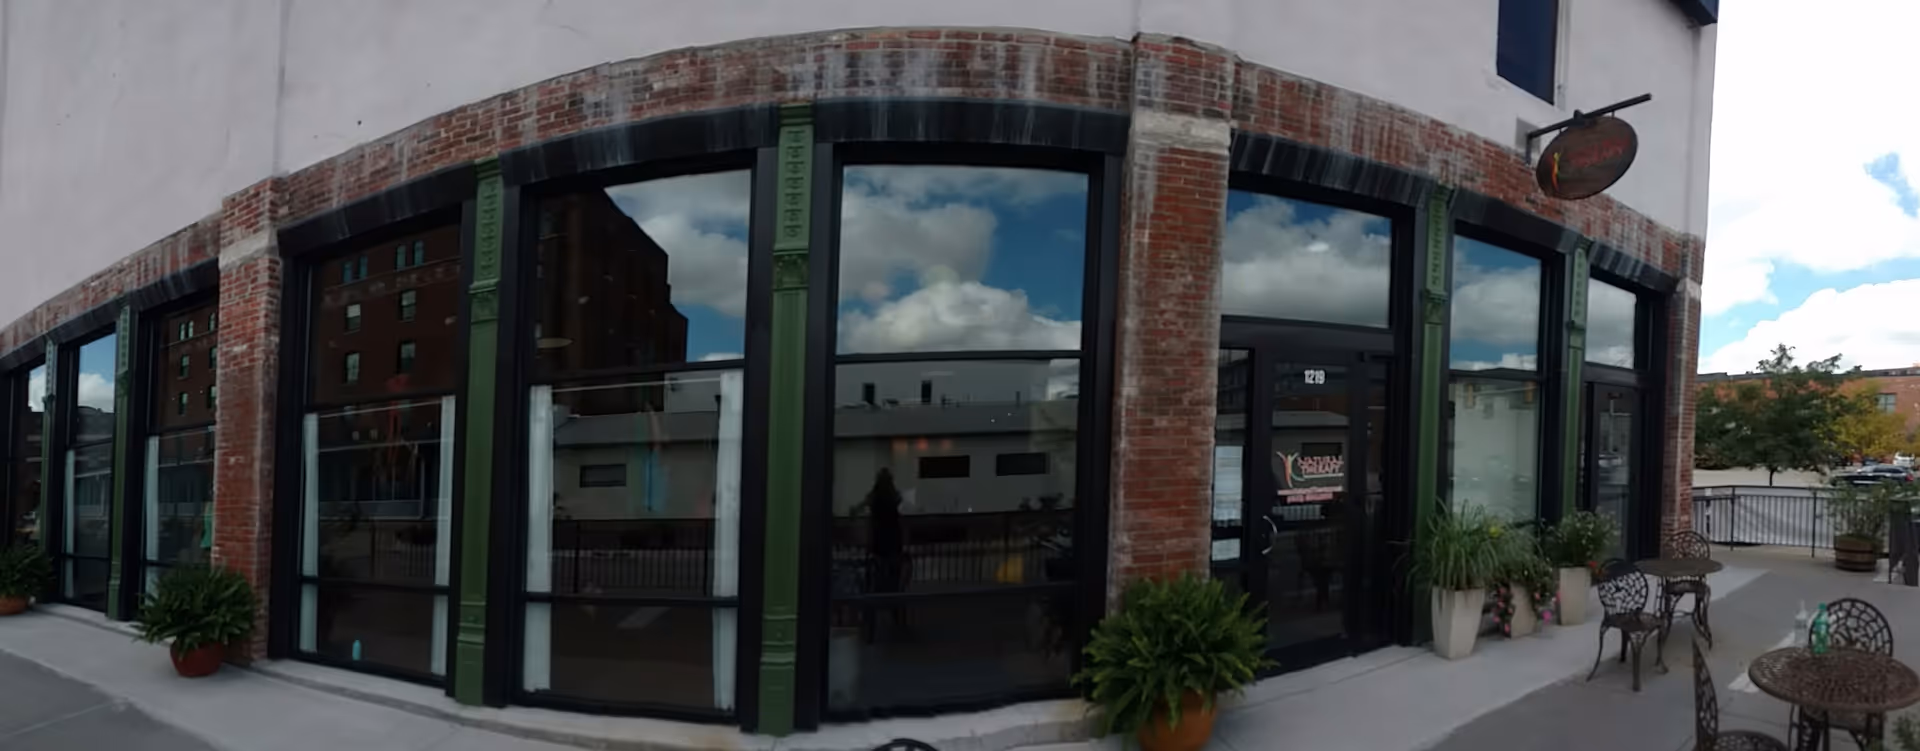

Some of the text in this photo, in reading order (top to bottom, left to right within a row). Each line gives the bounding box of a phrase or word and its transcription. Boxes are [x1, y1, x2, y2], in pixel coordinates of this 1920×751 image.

[1304, 369, 1325, 384] 1219
[1297, 455, 1344, 466] NATURAL
[1302, 464, 1341, 475] THERAPY
